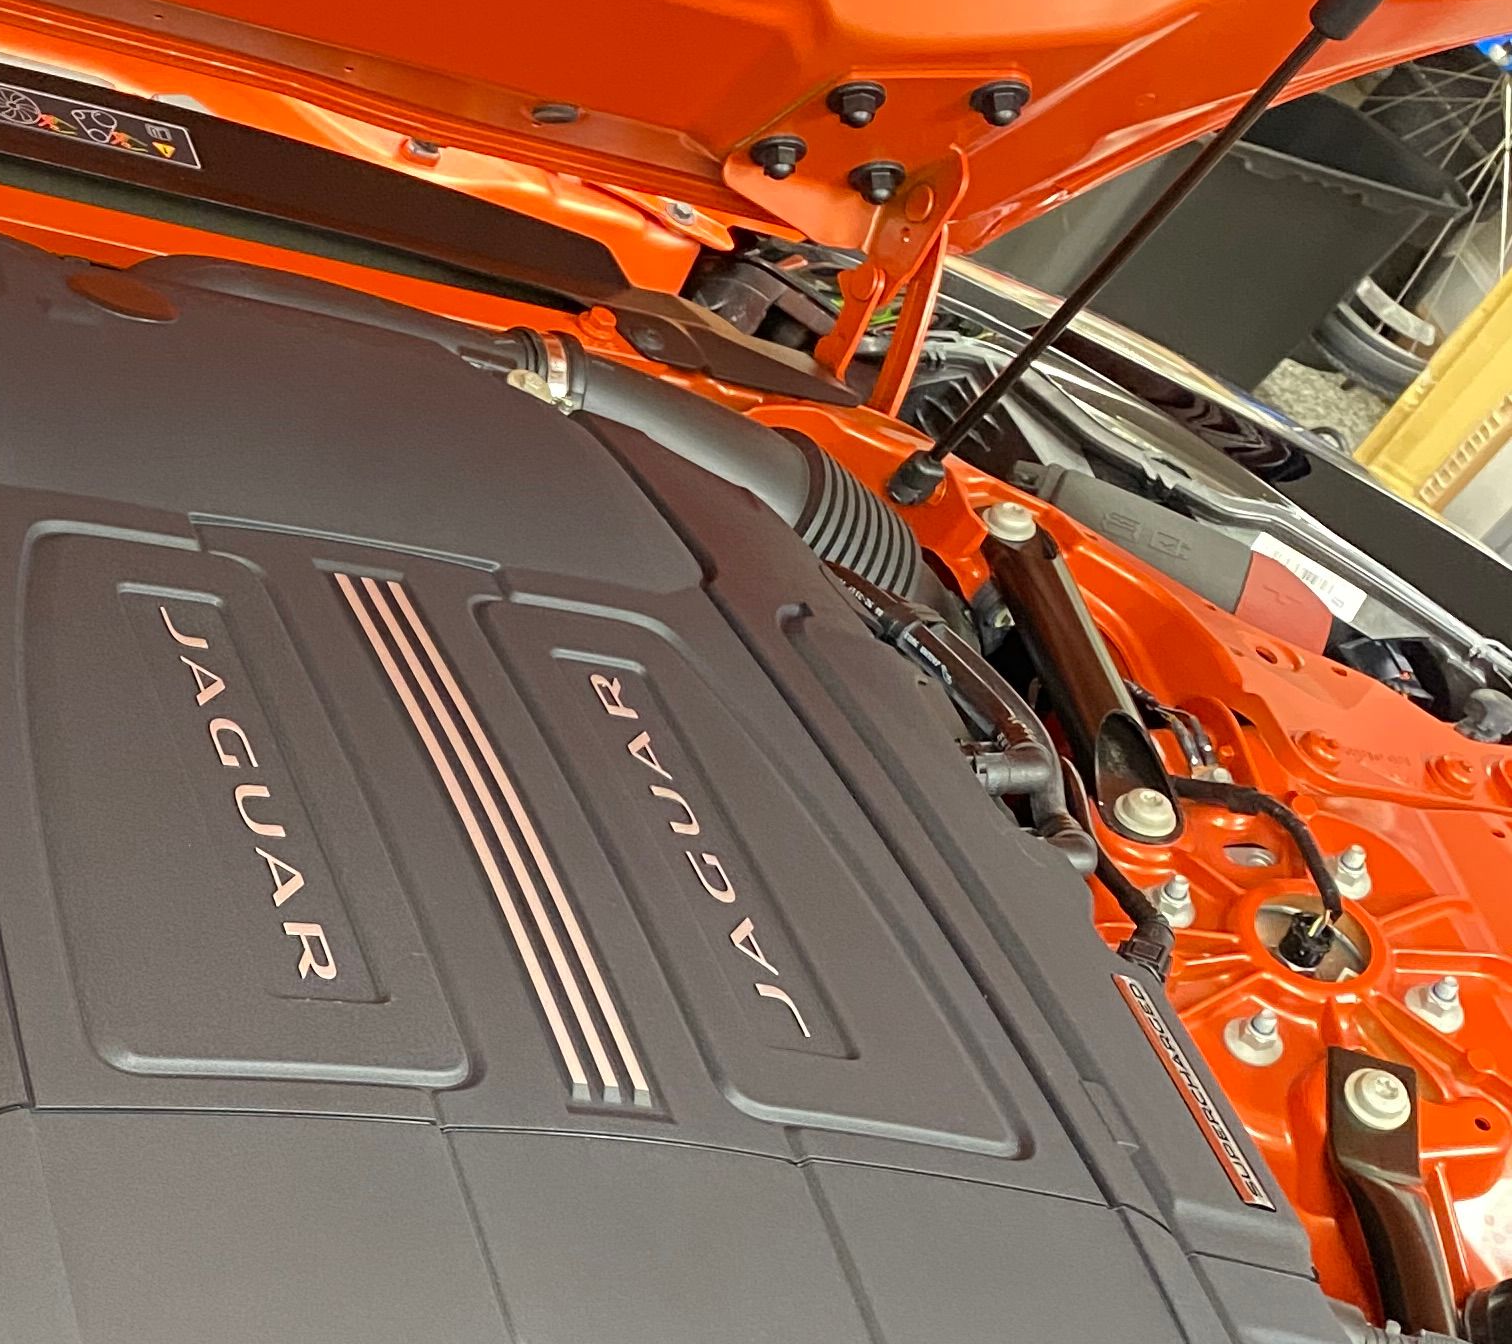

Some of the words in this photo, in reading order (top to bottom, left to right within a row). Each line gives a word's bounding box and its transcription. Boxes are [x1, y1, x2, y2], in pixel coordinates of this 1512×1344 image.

[160, 606, 337, 980] JAGUAR
[590, 673, 811, 1038] JAGUAR
[1129, 983, 1263, 1198] SUPERCHARGED
